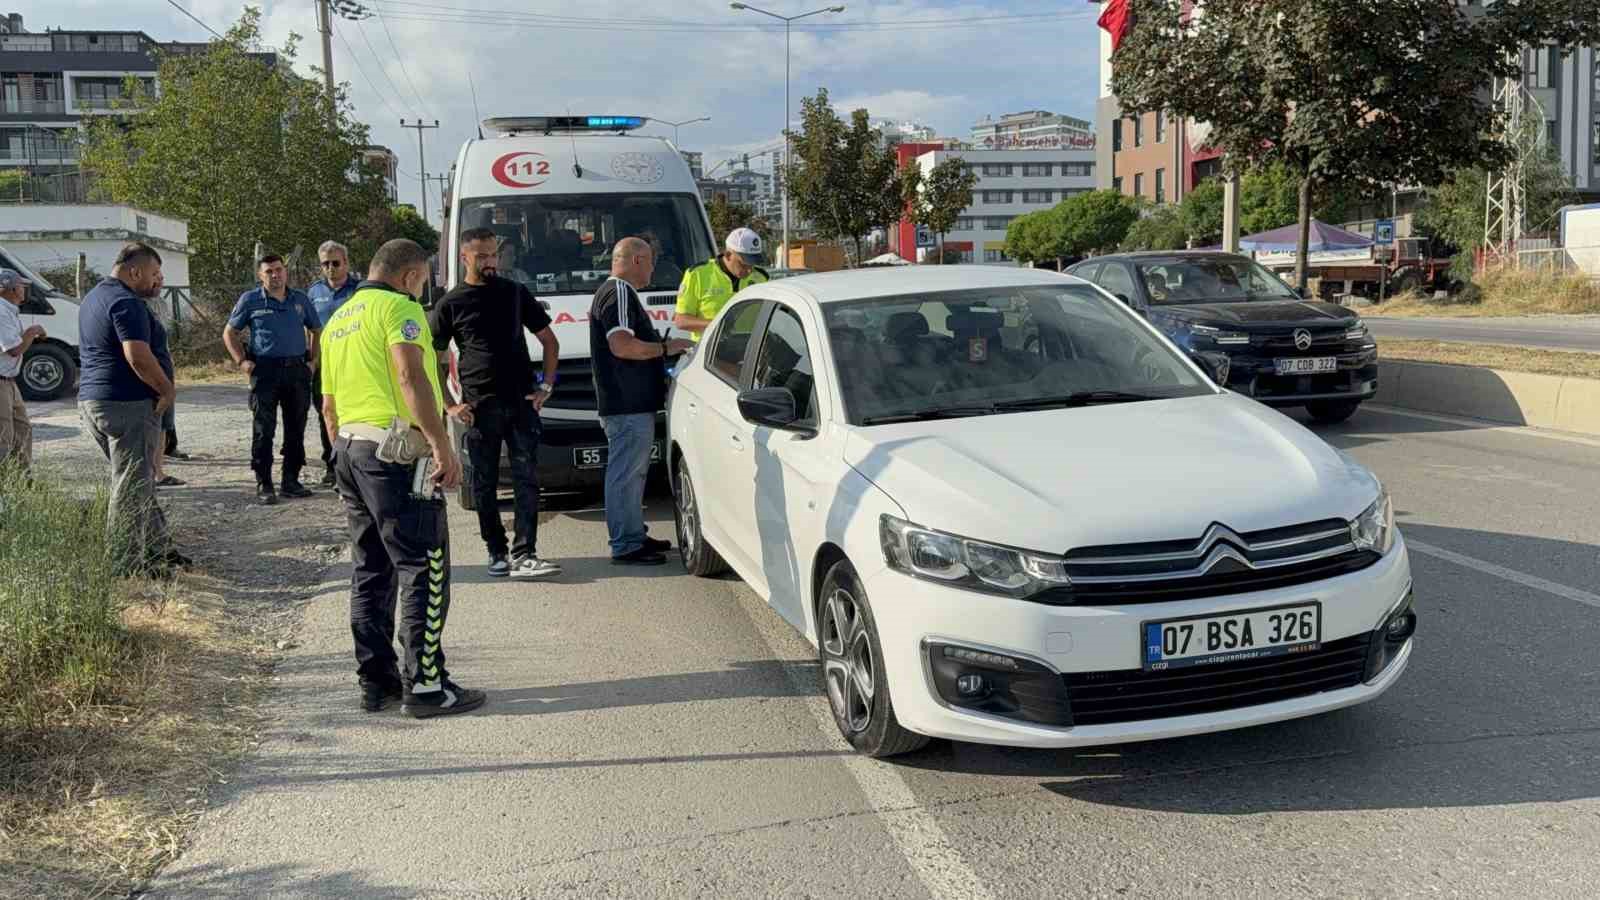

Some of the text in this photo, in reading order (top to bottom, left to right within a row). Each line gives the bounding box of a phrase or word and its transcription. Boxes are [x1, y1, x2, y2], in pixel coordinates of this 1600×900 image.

[507, 160, 550, 176] 112
[1281, 360, 1293, 371] 07
[1318, 358, 1335, 369] 322
[582, 449, 600, 464] 55
[1163, 611, 1313, 655] 07 BSA 326
[1149, 645, 1160, 655] TR
